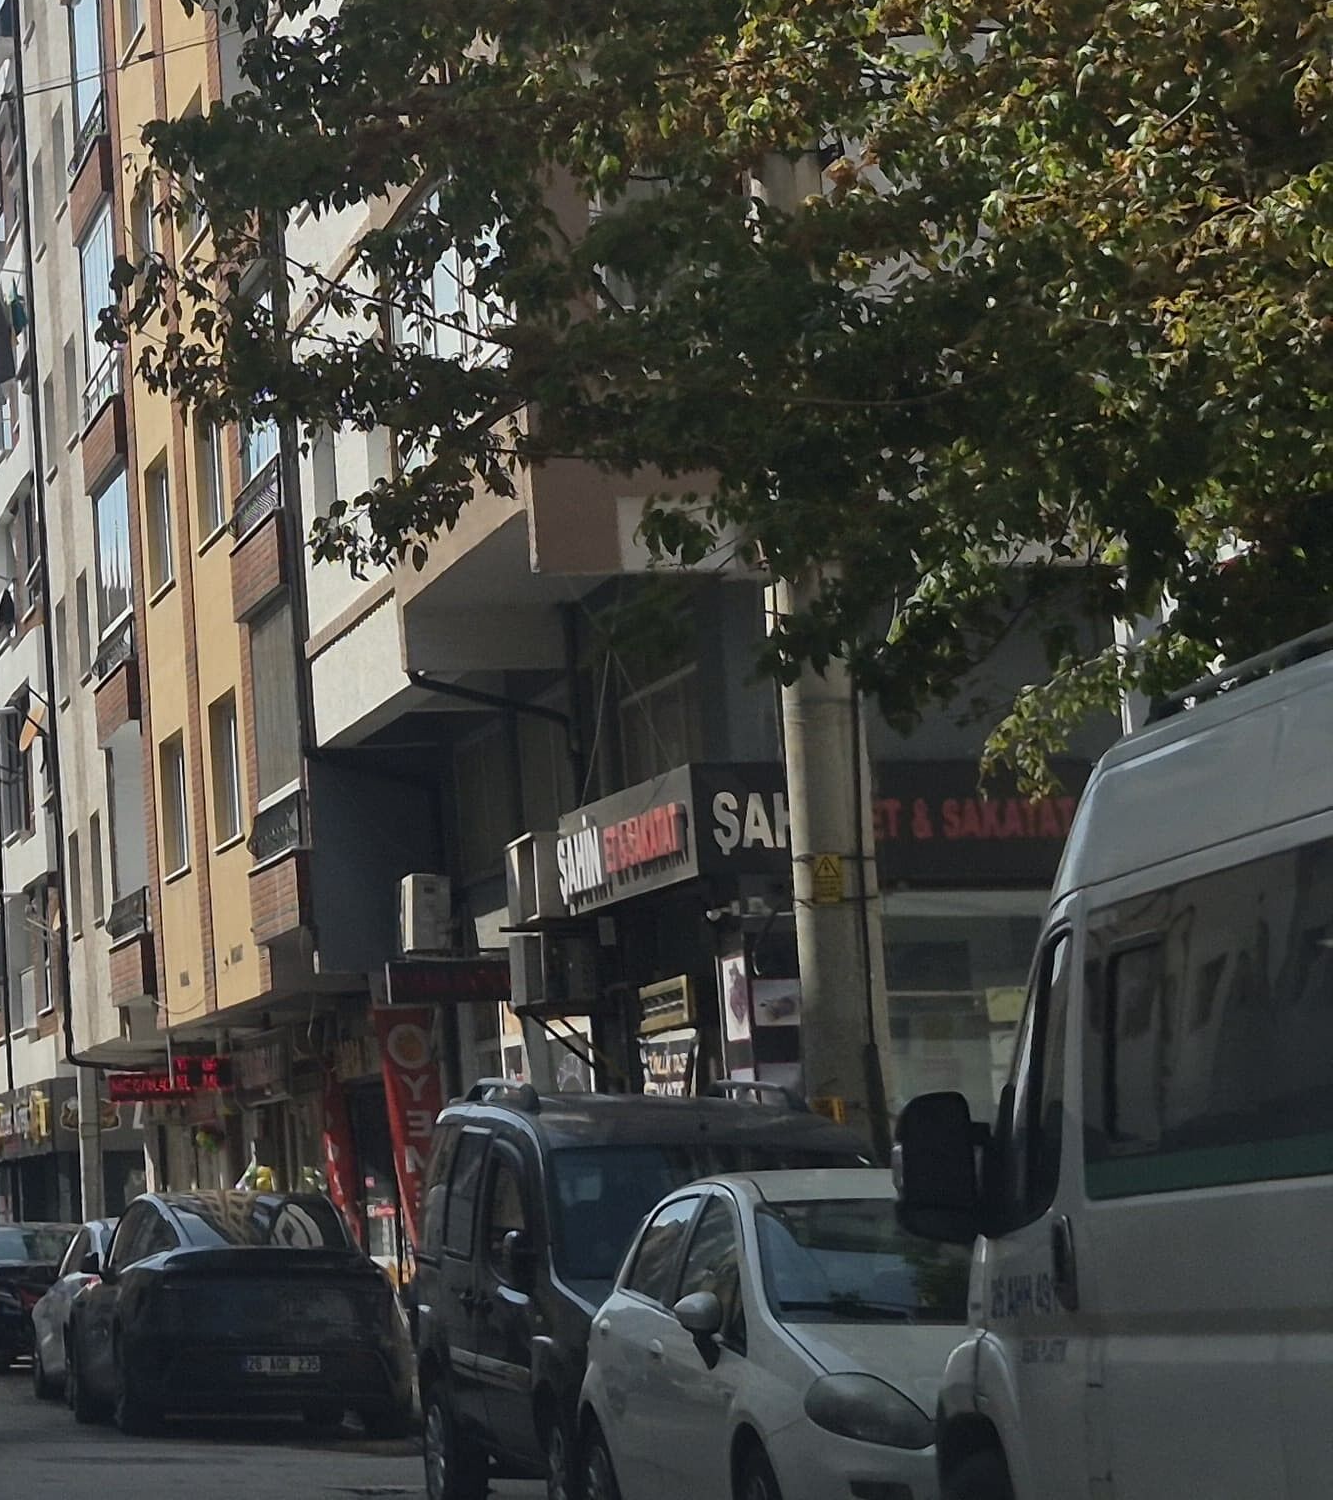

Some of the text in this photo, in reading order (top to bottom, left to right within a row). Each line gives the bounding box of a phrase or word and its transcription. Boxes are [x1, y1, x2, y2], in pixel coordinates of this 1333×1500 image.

[711, 790, 791, 857] ŞAH
[912, 798, 934, 841] &
[941, 796, 1077, 838] SAKATAT
